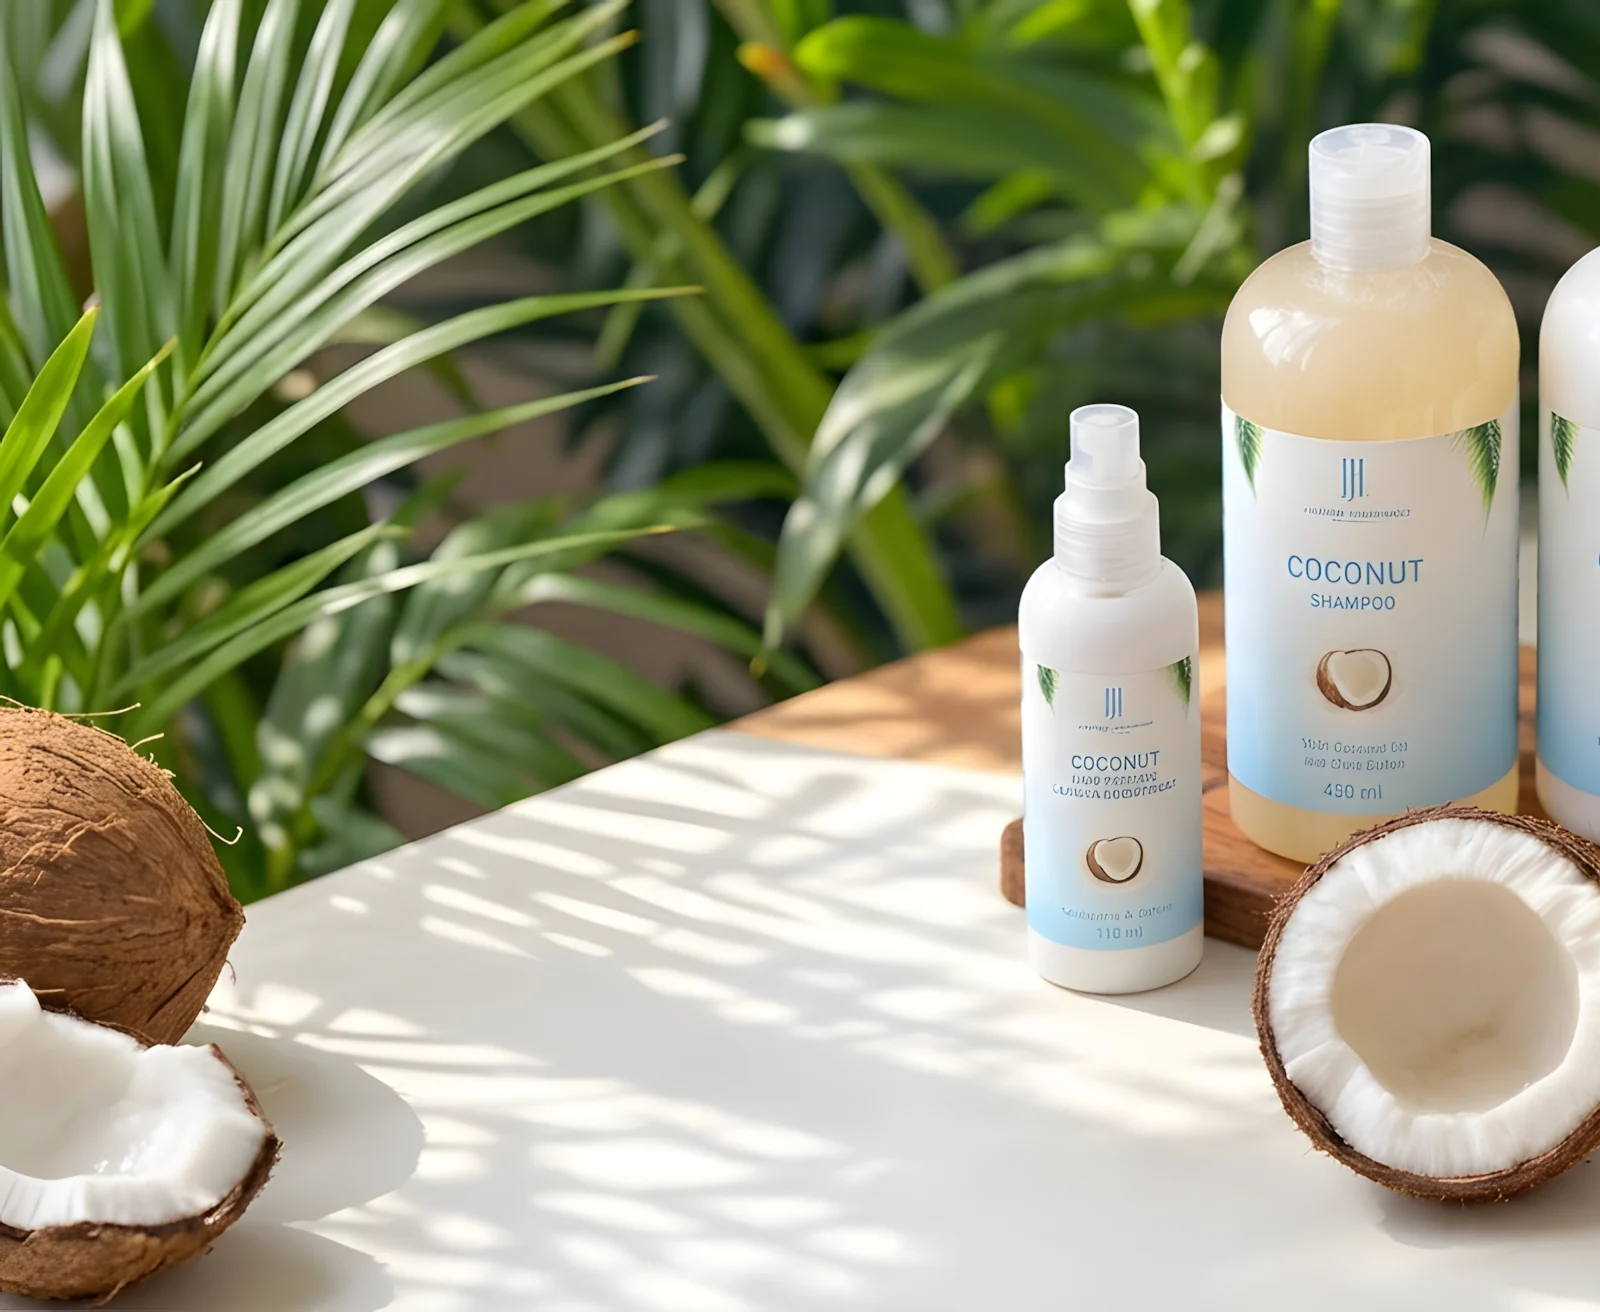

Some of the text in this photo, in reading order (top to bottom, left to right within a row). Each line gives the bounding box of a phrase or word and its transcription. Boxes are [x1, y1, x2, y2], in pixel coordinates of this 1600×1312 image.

[1287, 554, 1425, 585] COCONUT
[1309, 593, 1397, 611] SHAMPOO
[1071, 750, 1160, 772] COCONUT
